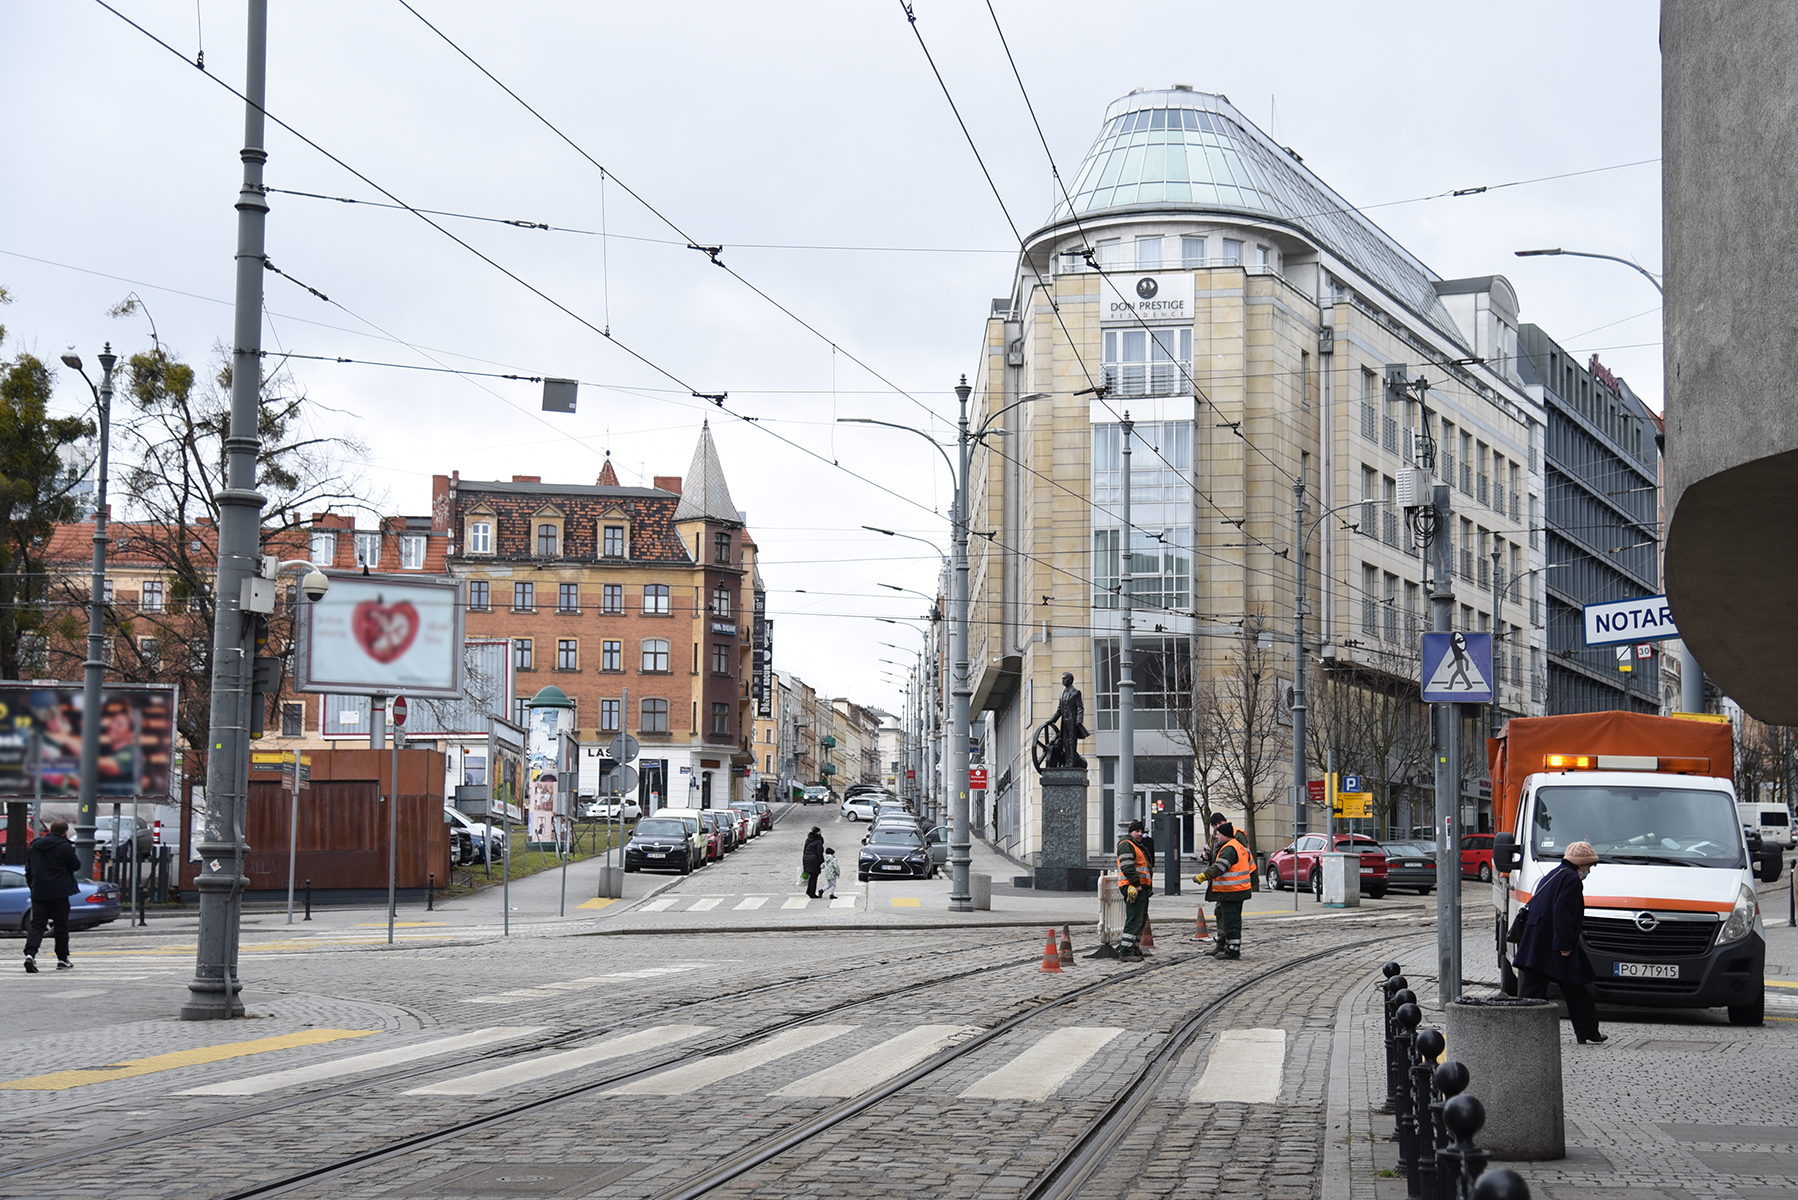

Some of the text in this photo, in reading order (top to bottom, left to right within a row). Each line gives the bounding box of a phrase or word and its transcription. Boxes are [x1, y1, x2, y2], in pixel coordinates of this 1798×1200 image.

[1110, 300, 1185, 312] DON PRESTIGE
[1595, 606, 1675, 634] NOTAR
[1638, 647, 1650, 656] 30
[1620, 964, 1677, 977] PO 7T915
